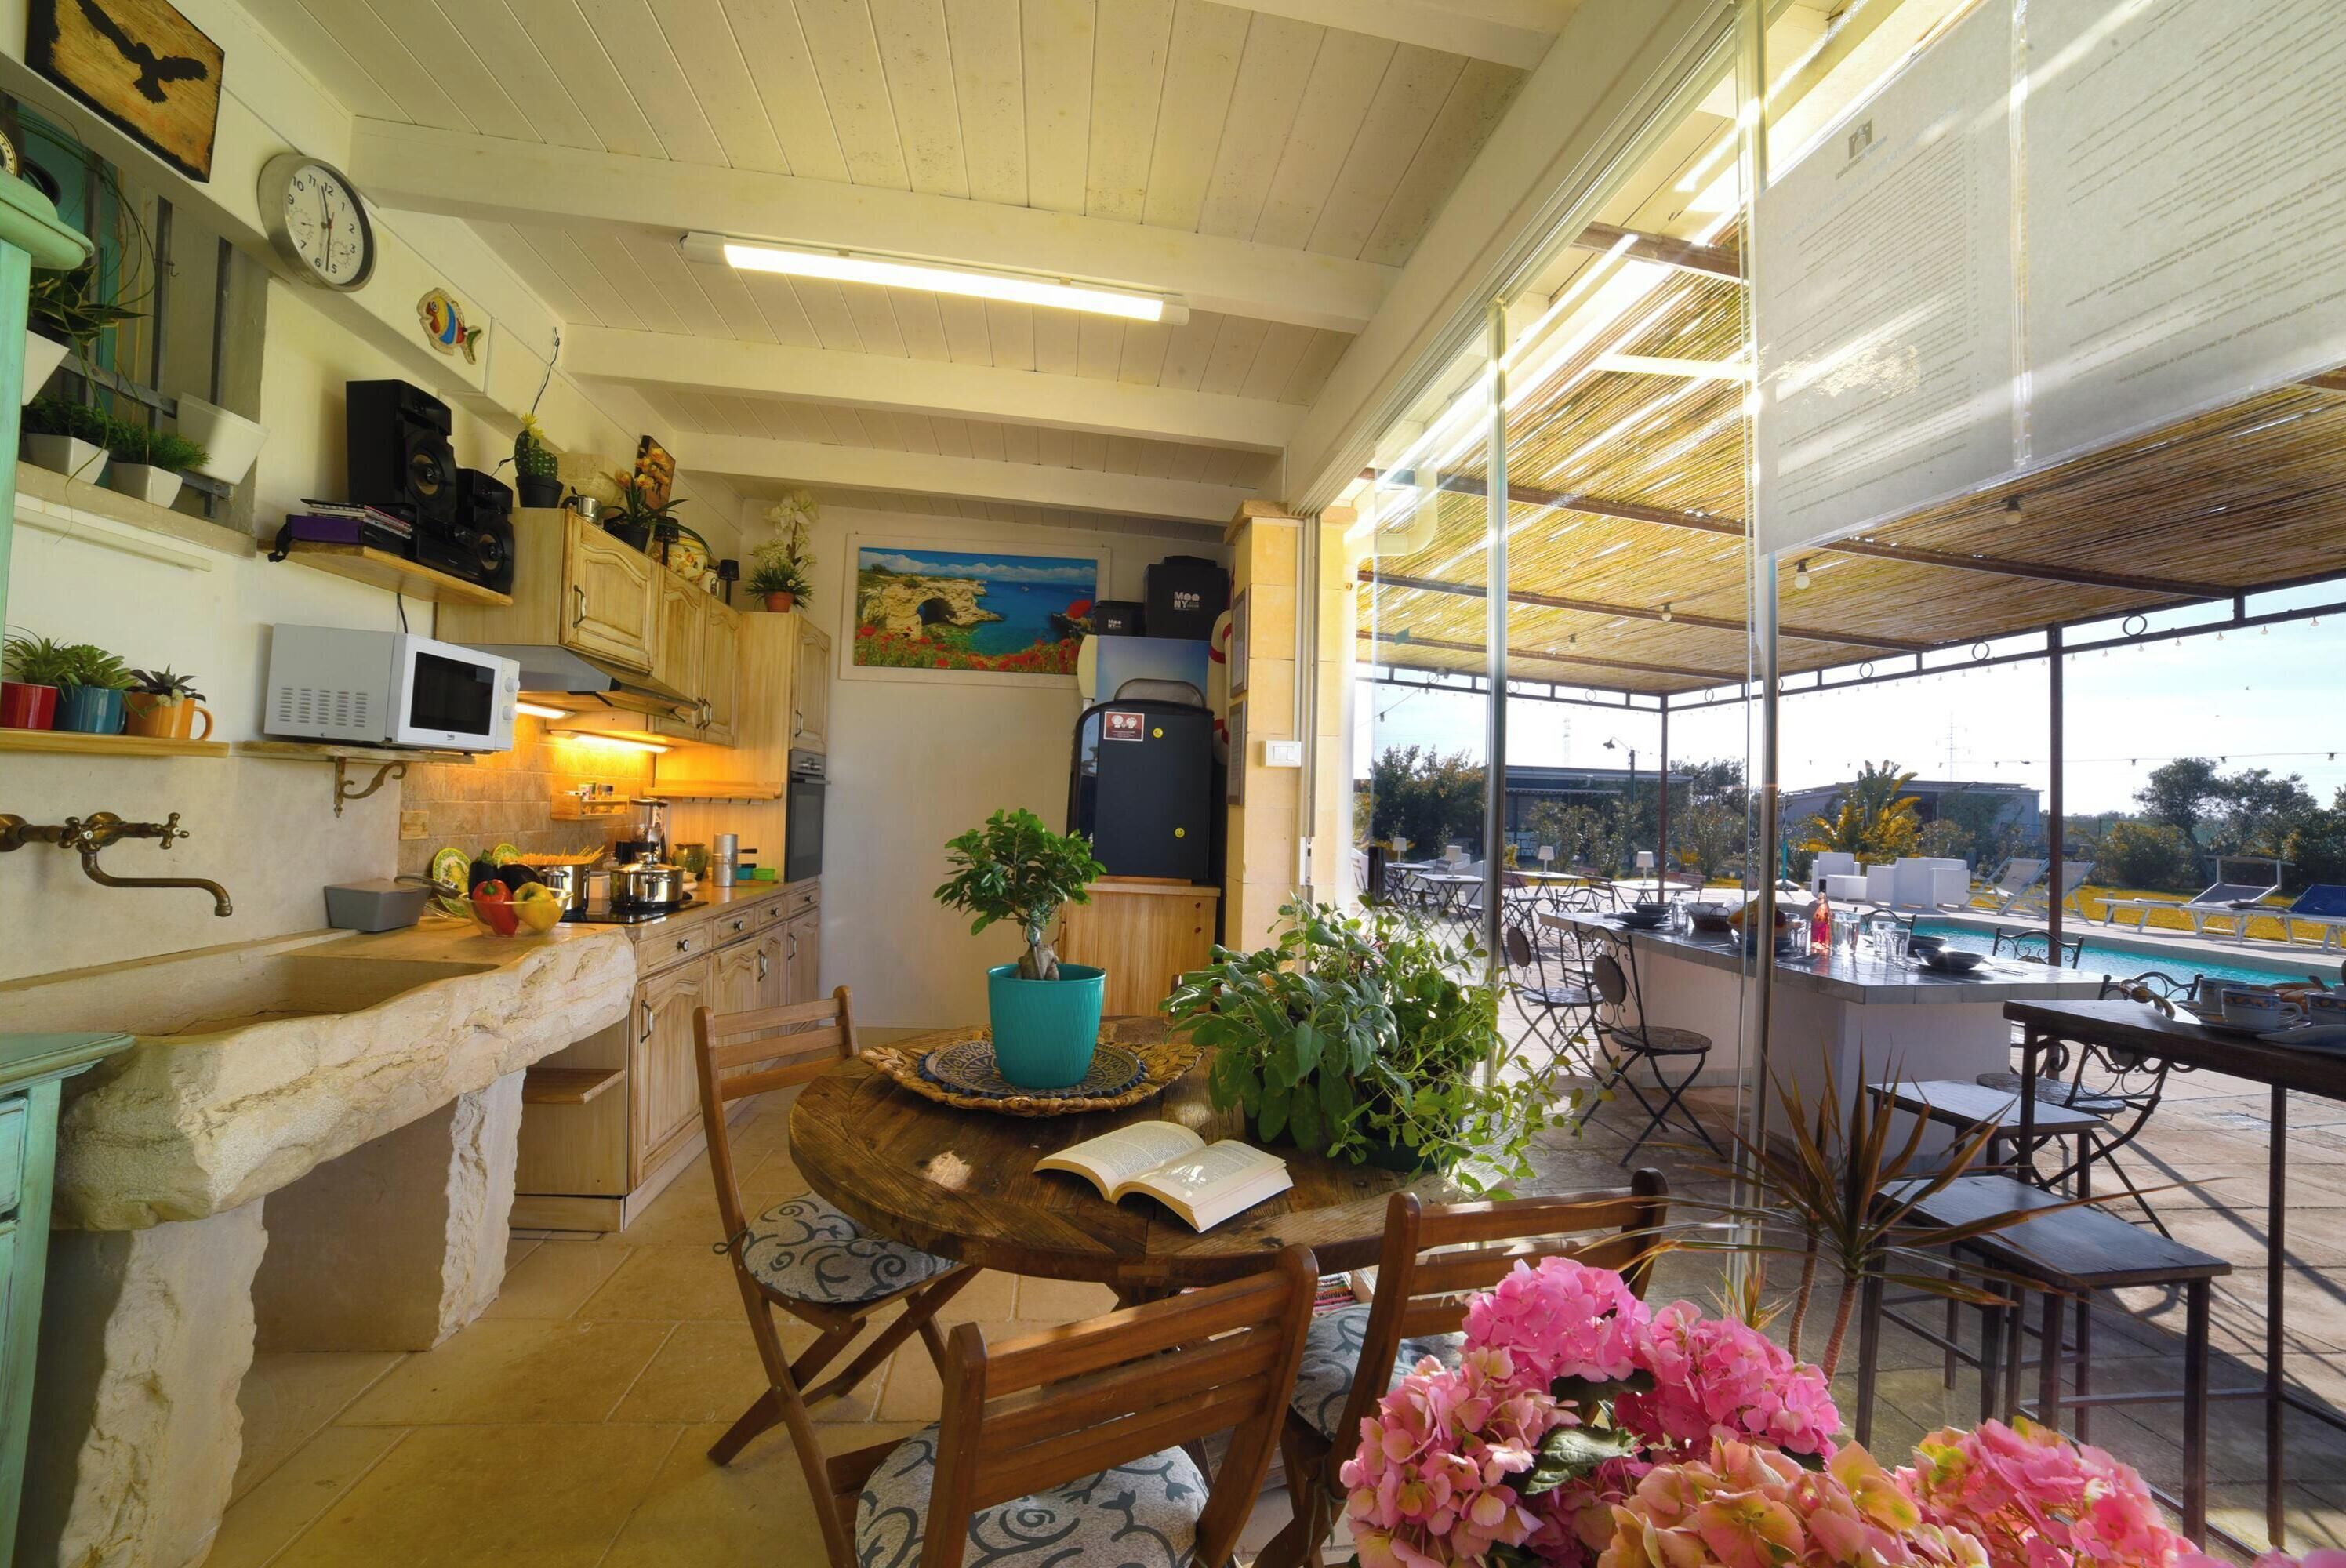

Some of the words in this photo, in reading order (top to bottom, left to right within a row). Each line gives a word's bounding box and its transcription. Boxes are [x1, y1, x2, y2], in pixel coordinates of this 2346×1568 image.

[292, 176, 304, 191] 10
[308, 174, 316, 187] 11
[323, 182, 333, 196] 12
[288, 194, 294, 205] 9
[341, 201, 345, 212] 1
[349, 223, 354, 233] 2
[300, 240, 307, 249] 7
[350, 244, 355, 254] 3
[314, 257, 321, 267] 6
[331, 264, 337, 274] 5
